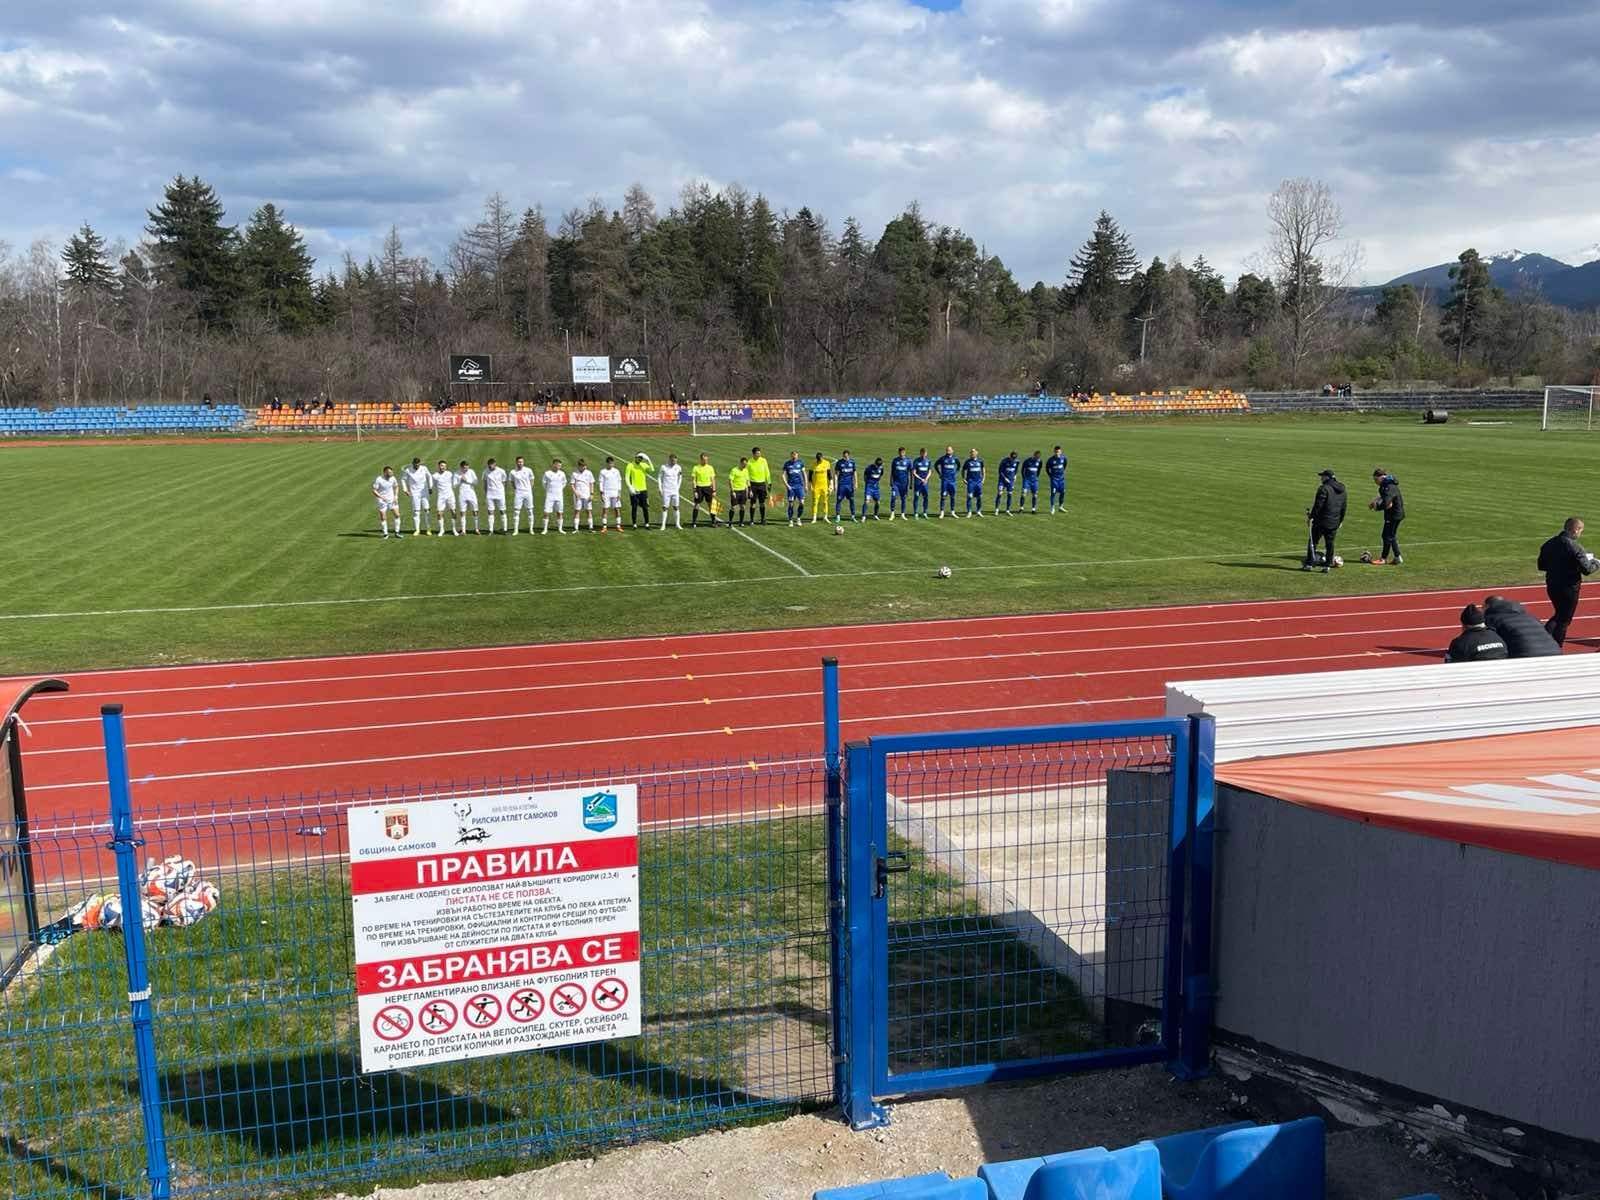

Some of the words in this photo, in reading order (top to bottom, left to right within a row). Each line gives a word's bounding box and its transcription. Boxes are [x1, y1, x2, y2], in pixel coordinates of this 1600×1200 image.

[413, 414, 458, 426] WINBET
[468, 413, 512, 425] WINBET
[522, 412, 565, 424] WINBET
[575, 411, 617, 422] WINBET
[625, 410, 667, 421] WINBET
[472, 816, 499, 825] РИЛСКИ
[501, 814, 522, 822] АТЛЕТ
[523, 811, 558, 820] САМОКОВ
[359, 845, 396, 856] ОБЩИНА
[397, 841, 437, 852] САМОКОВ
[416, 846, 579, 884] ПРАВИЛА
[374, 896, 384, 904] ЗА
[386, 893, 414, 902] БЯГАНЕ
[416, 889, 450, 900] (ХОДЕНЕ)
[451, 887, 461, 895] СЕ
[463, 884, 504, 893] ИЗПОЛЗВАТ
[506, 877, 560, 889] НАЙ-ВЪНШНИТЕ
[563, 874, 599, 883] КОРИДОРИ
[446, 894, 486, 905] ПИСТАТА
[489, 892, 500, 900] НЕ
[502, 890, 514, 899] СЕ
[362, 925, 373, 933] ПО
[375, 923, 399, 931] ВРЕМЕ
[413, 916, 460, 926] ТРЕНИРОВКИ
[473, 908, 531, 920] СЪСТЕЗАТЕЛИТЕ
[544, 904, 566, 912] КЛУБА
[597, 897, 632, 906] АТЛЕТИКА
[436, 907, 461, 916] ИЗВЪН
[463, 903, 497, 913] РАБОТНО
[498, 901, 521, 909] ВРЕМЕ
[366, 933, 377, 941] ПО
[379, 931, 404, 939] ВРЕМЕ
[467, 917, 512, 929] ОФИЦИАЛНИ
[520, 913, 560, 923] КОНТРОЛНИ
[562, 910, 587, 919] СРЕЩИ
[381, 940, 396, 948] ПРИ
[397, 935, 448, 946] ИЗВЪРШВАНЕ
[461, 928, 500, 939] ДЕЙНОСТИ
[512, 922, 544, 933] ПИСТАТА
[551, 918, 593, 928] ФУТБОЛНИЯ
[594, 915, 616, 923] ТЕРЕН
[444, 941, 454, 949] ОТ
[456, 936, 498, 947] СЛУЖИТЕЛИ
[511, 932, 534, 941] ДВАТА
[535, 930, 558, 938] КЛУБА
[377, 943, 574, 989] ЗАБРАНЯВА
[581, 937, 622, 963] СЕ
[385, 984, 480, 1004] НЕРЕГЛАМЕНТИРАНО
[481, 980, 521, 992] ВЛИЗАНЕ
[523, 978, 535, 986] НА
[537, 972, 588, 984] ФУТБОЛНИЯ
[590, 967, 617, 978] ТЕРЕН
[374, 1040, 420, 1054] КАРАНЕТО
[422, 1038, 435, 1047] ПО
[438, 1032, 477, 1044] ПИСТАТА
[480, 1030, 491, 1038] НА
[428, 1045, 462, 1056] ДЕТСКИ
[464, 1039, 504, 1051] КОЛИЧКИ
[506, 1037, 512, 1045] И
[513, 1030, 570, 1044] РАЗХОЖДАНЕ
[572, 1028, 584, 1036] НА
[586, 1023, 616, 1035] КУЧЕТА
